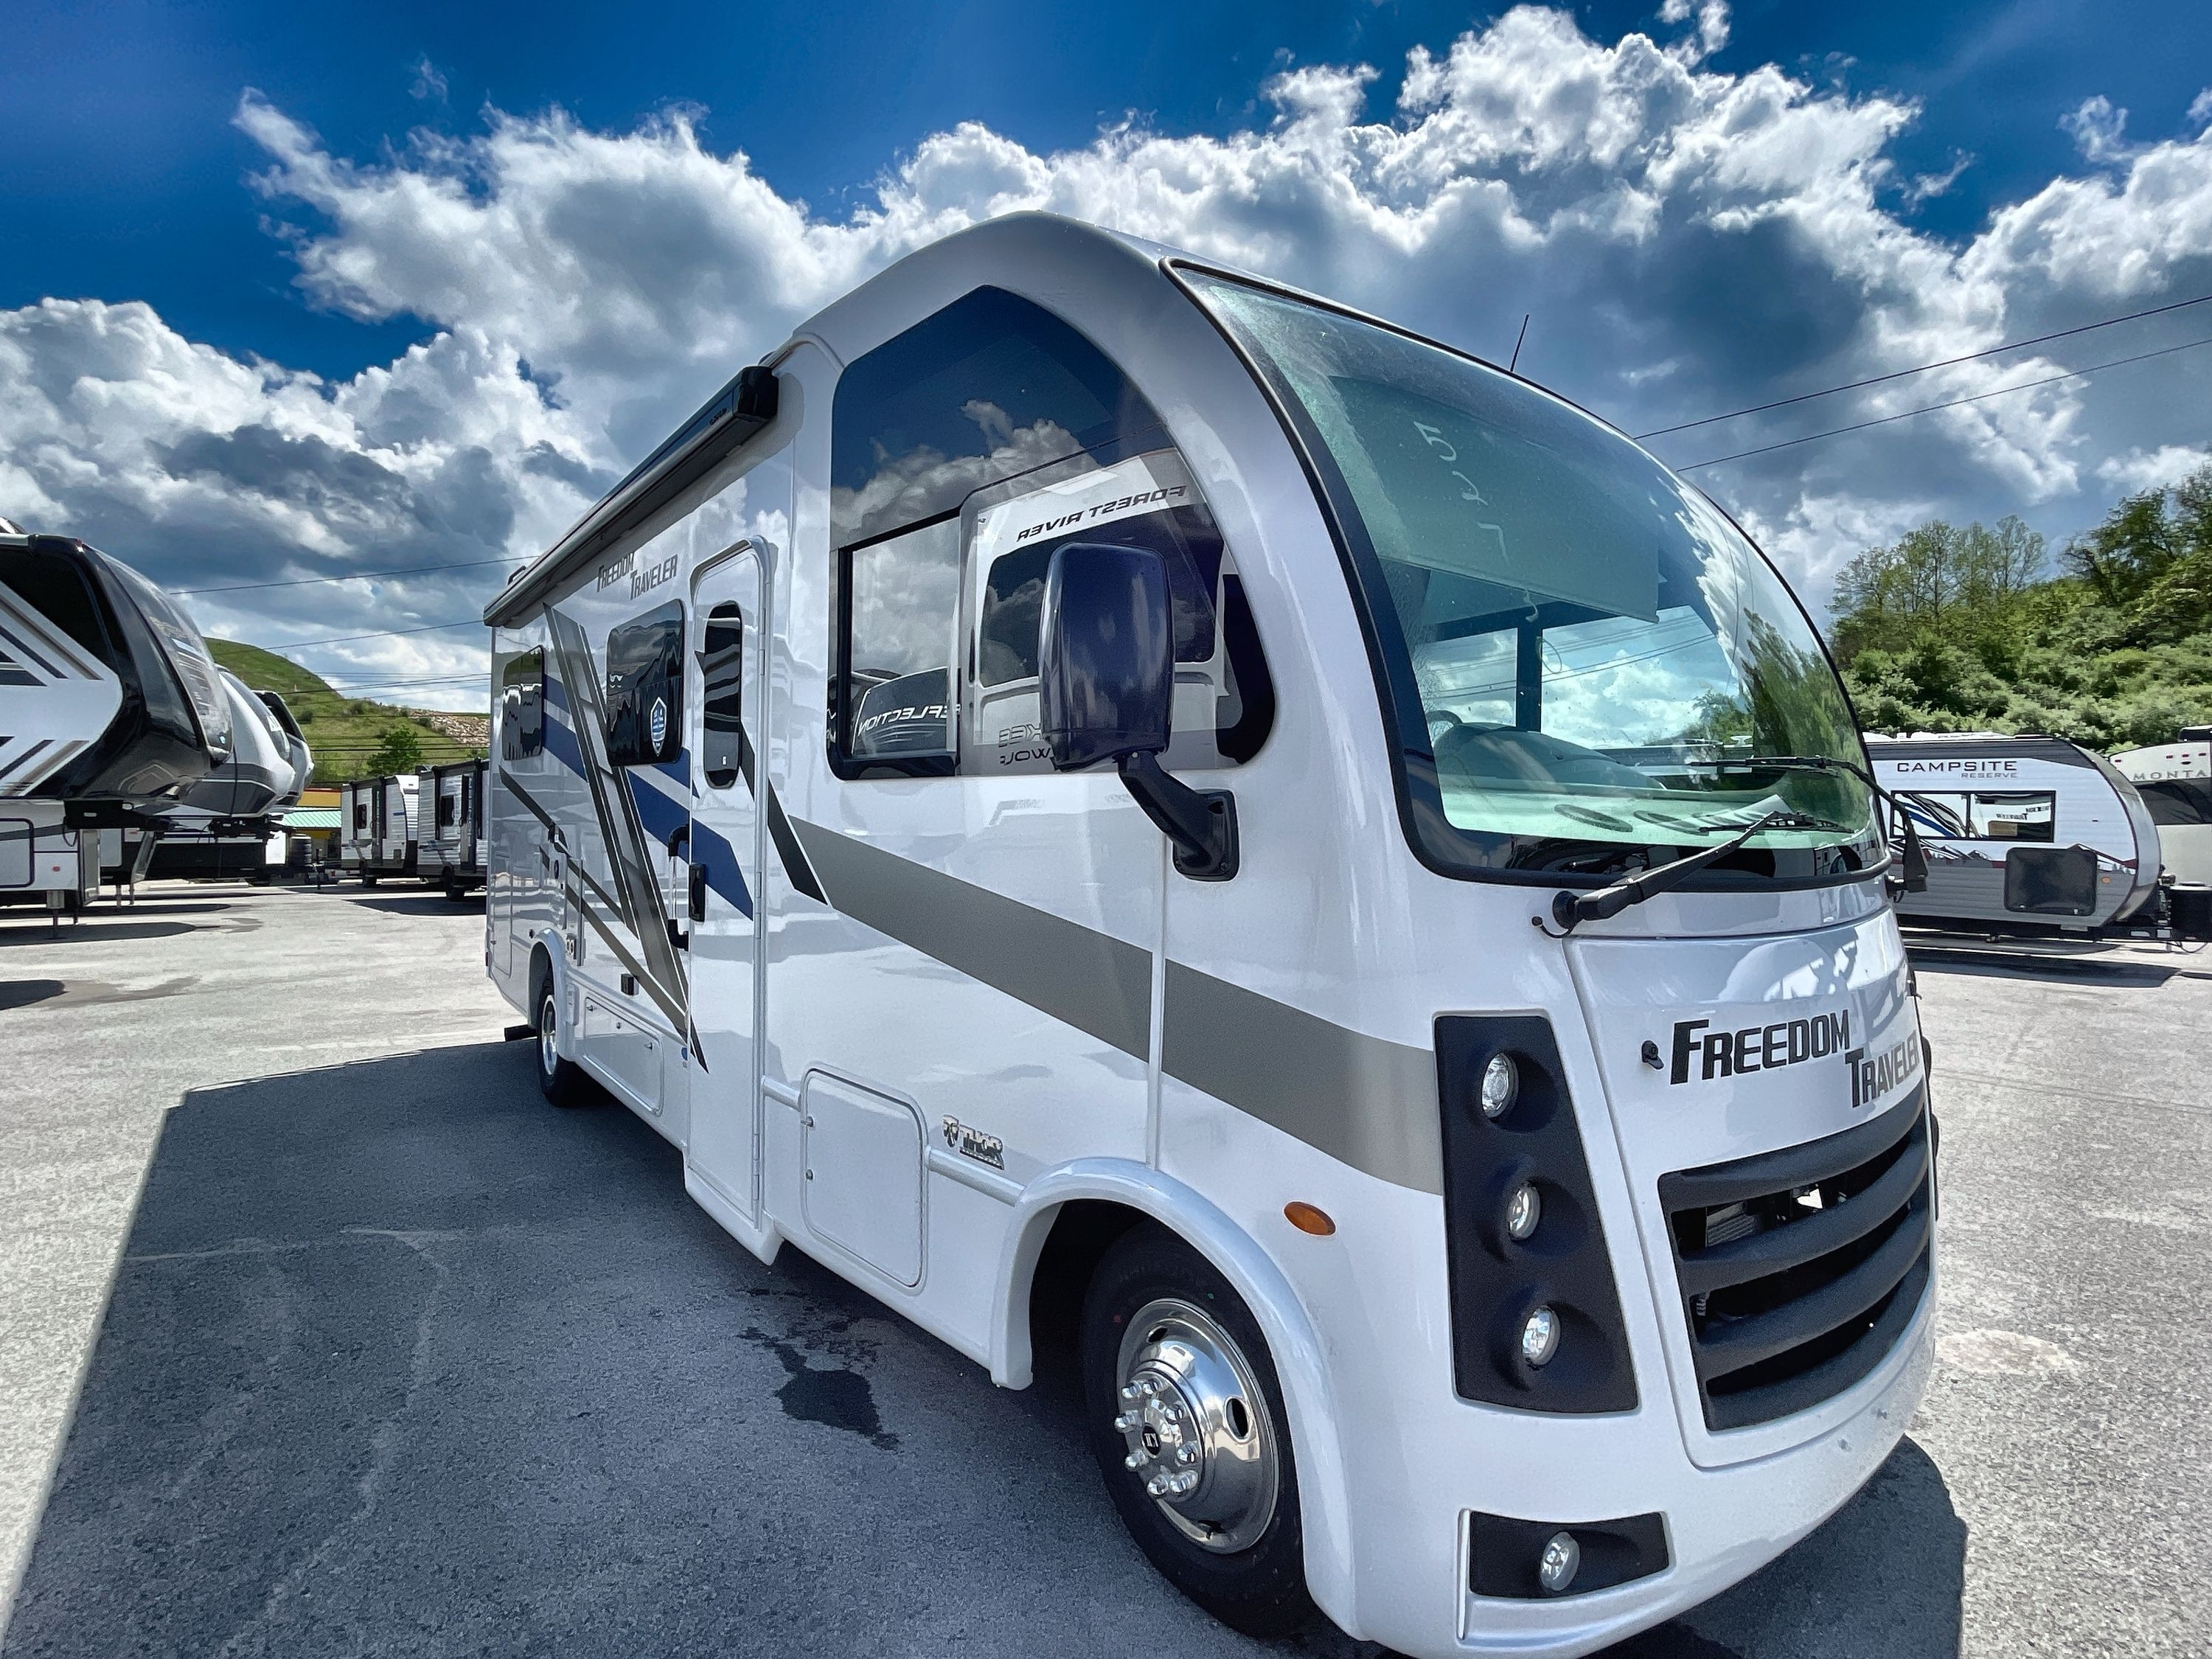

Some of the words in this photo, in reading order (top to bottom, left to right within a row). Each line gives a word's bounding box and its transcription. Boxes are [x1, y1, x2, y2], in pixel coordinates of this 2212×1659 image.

[597, 552, 635, 593] FREEDOM
[630, 554, 678, 601] TRAVELER
[1897, 761, 2017, 773] CAMPSITE
[1669, 1009, 1851, 1085] FREEDOM
